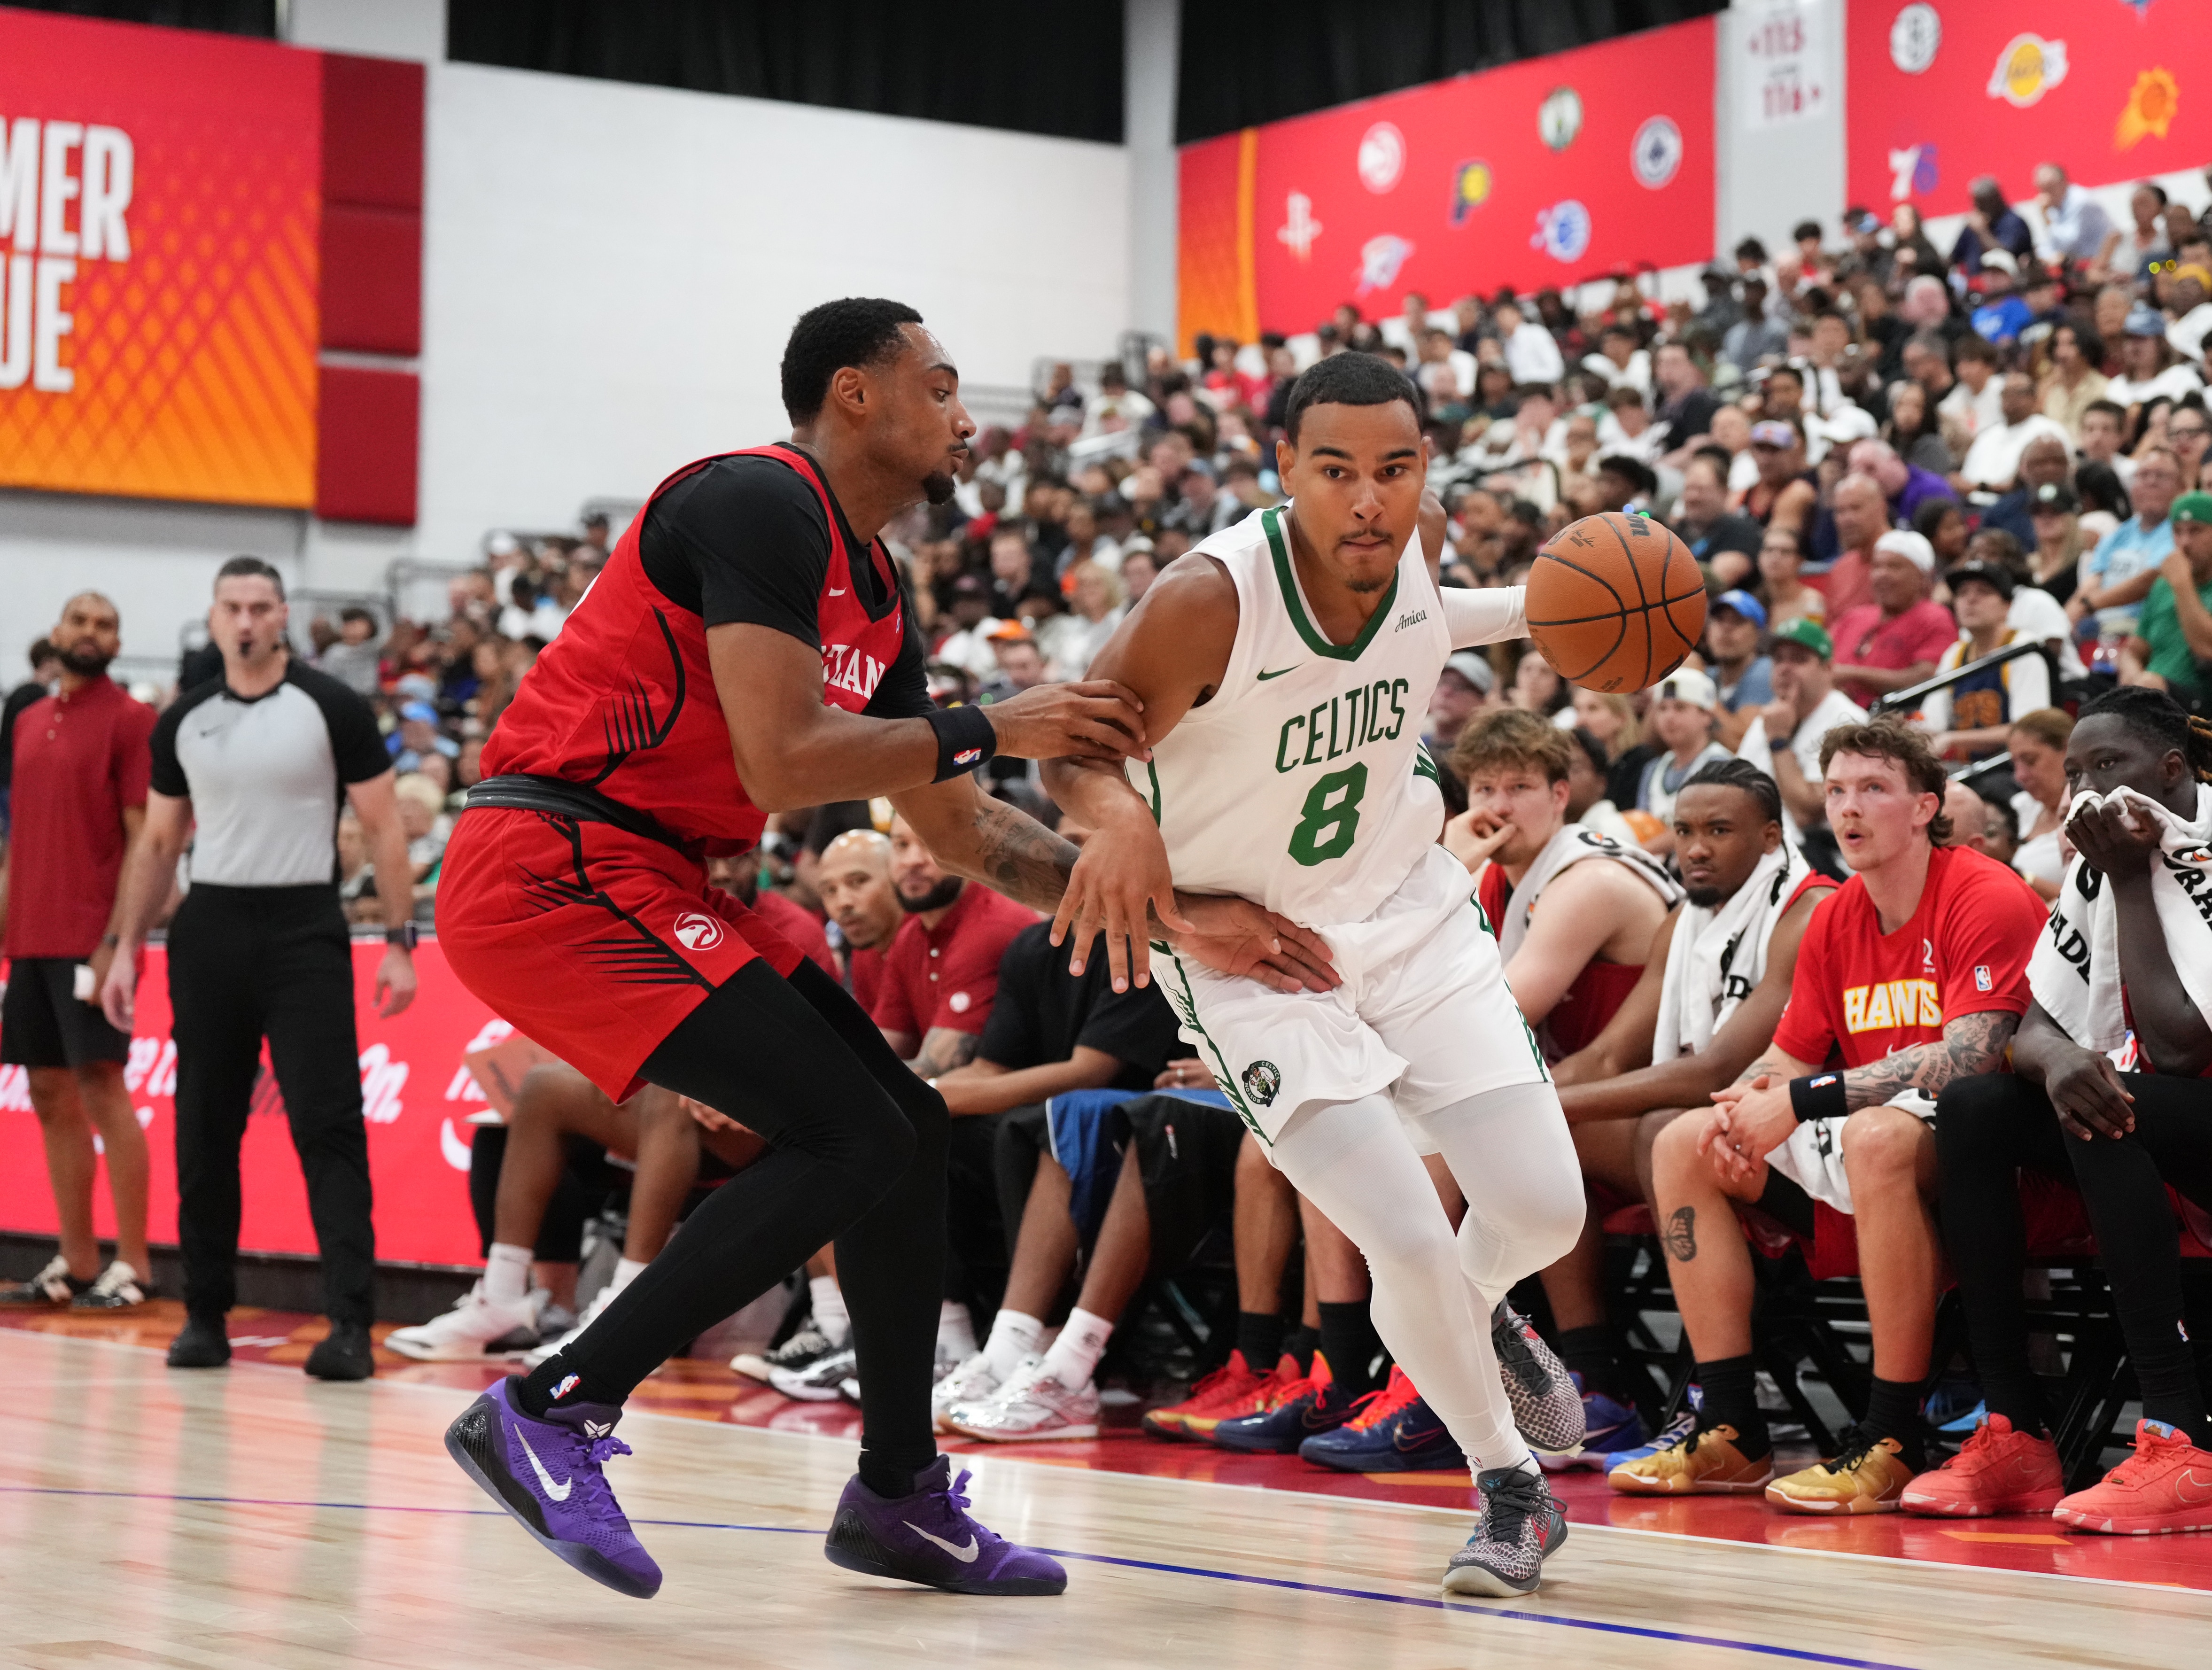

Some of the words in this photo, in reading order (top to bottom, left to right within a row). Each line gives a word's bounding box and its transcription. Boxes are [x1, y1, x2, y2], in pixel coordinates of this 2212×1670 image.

[1395, 610, 1428, 633] Amica
[1275, 678, 1409, 773] CELTICS
[1288, 761, 1368, 867] 8
[1843, 978, 1944, 1035] HAWS
[1261, 1061, 1280, 1081] CELTICS
[1244, 1082, 1261, 1103] BOSTON
